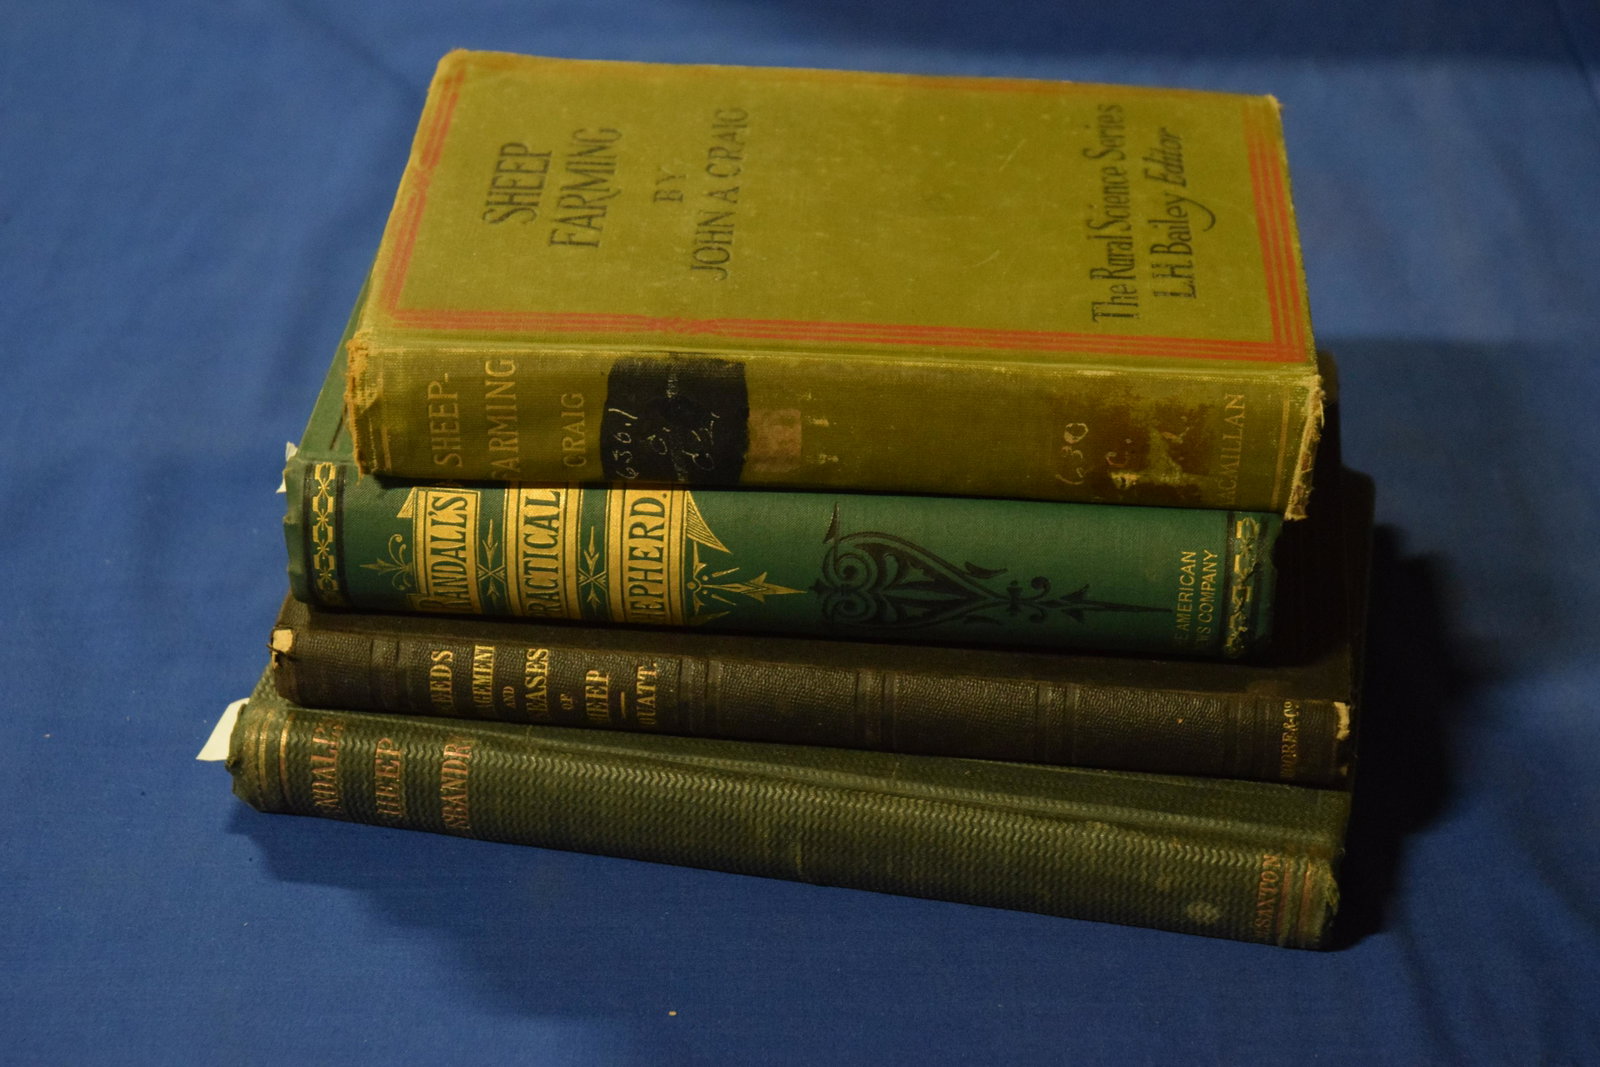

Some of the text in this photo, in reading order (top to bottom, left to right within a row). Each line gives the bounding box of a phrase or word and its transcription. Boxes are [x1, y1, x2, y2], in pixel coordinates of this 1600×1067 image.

[482, 141, 552, 225] SHEEP
[549, 127, 622, 248] FARMING
[654, 165, 688, 203] BY
[691, 106, 749, 281] JOHN A CRAIG
[1141, 126, 1187, 187] Editor
[1082, 103, 1140, 323] The Rural Science Series
[1148, 192, 1216, 256] Bailey
[560, 392, 587, 468] CRAIG
[418, 497, 469, 613] RANDALL'S
[628, 493, 668, 622] HEPHERD.
[1176, 551, 1197, 632] AMERICAN
[1198, 550, 1218, 624] COMPANY
[429, 650, 453, 708] EEDS
[502, 685, 517, 709] AND
[560, 693, 574, 711] OF
[636, 662, 658, 726] OUATT.
